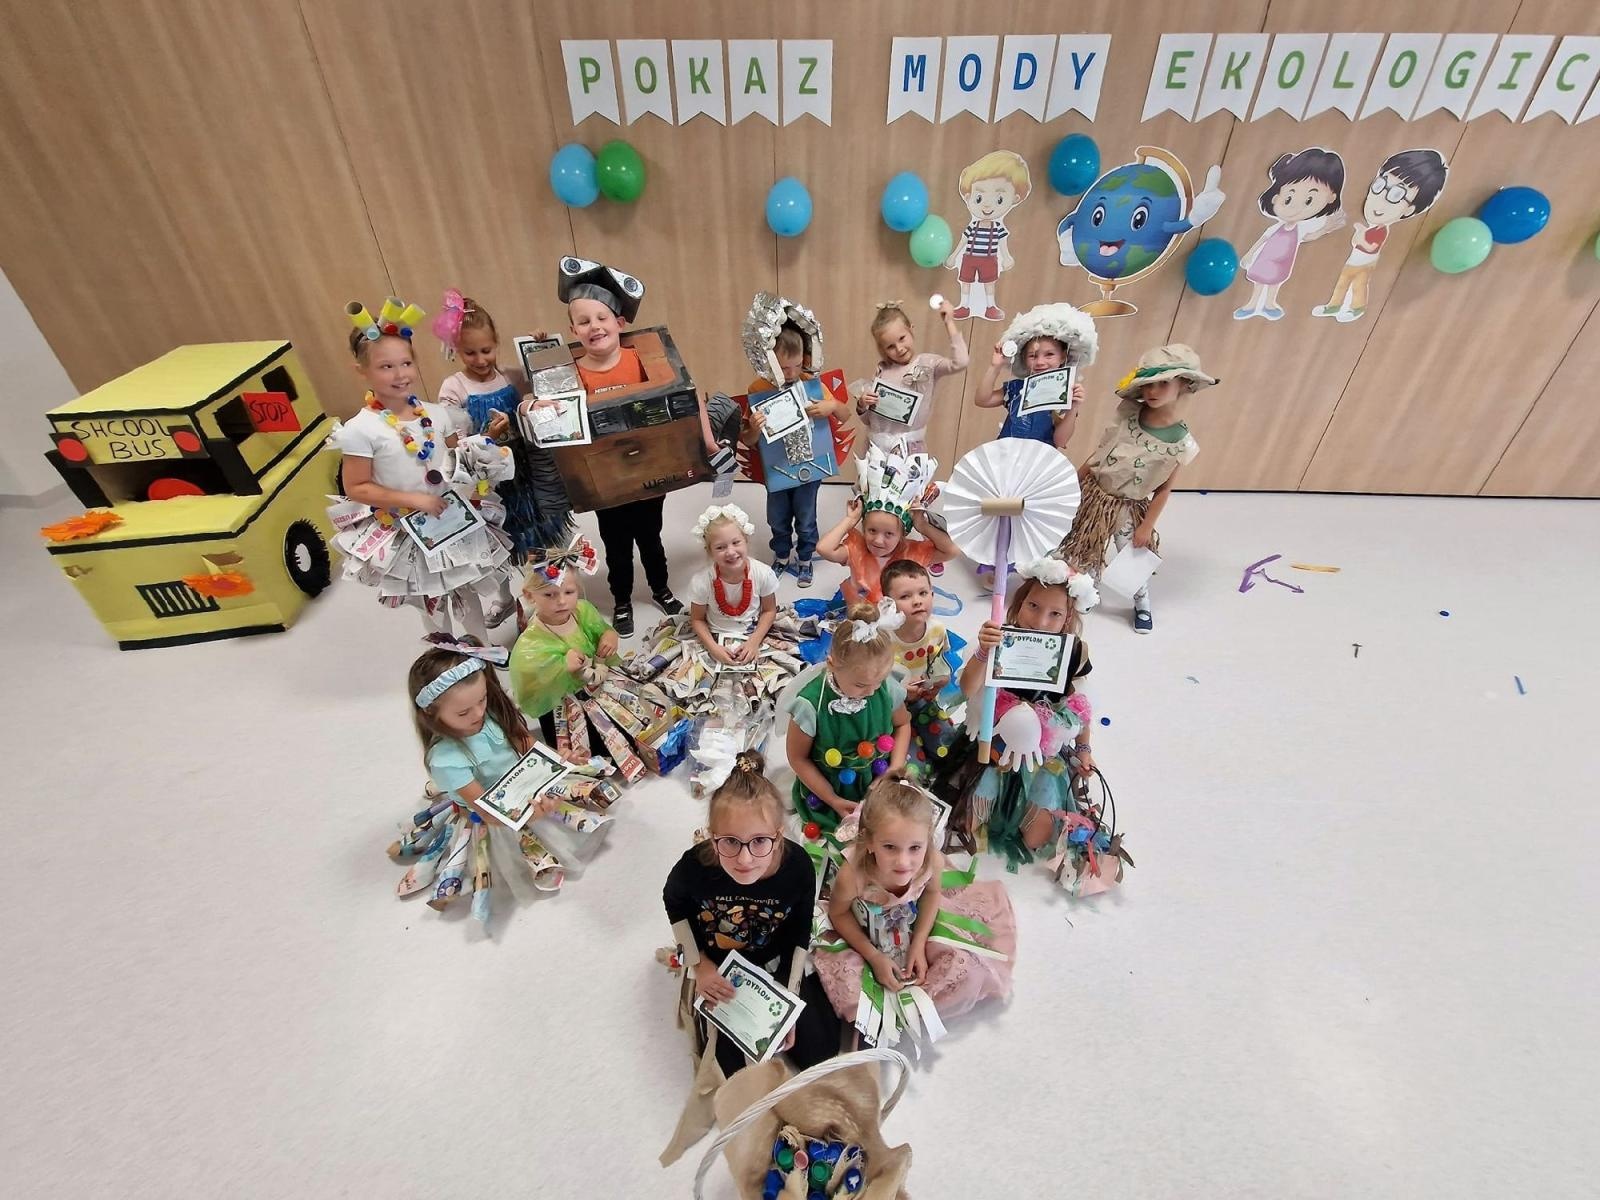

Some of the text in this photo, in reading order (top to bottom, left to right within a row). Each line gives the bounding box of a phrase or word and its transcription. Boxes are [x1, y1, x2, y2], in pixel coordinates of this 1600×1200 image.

[579, 49, 1591, 94] POKAZ MODY EKOLOGIC
[250, 401, 288, 424] STOP
[71, 418, 171, 440] SHCOOL
[109, 439, 167, 460] BUS
[1017, 635, 1043, 643] DYPLOM
[502, 767, 525, 788] DYPLOM
[746, 979, 771, 1001] DYPLOM
